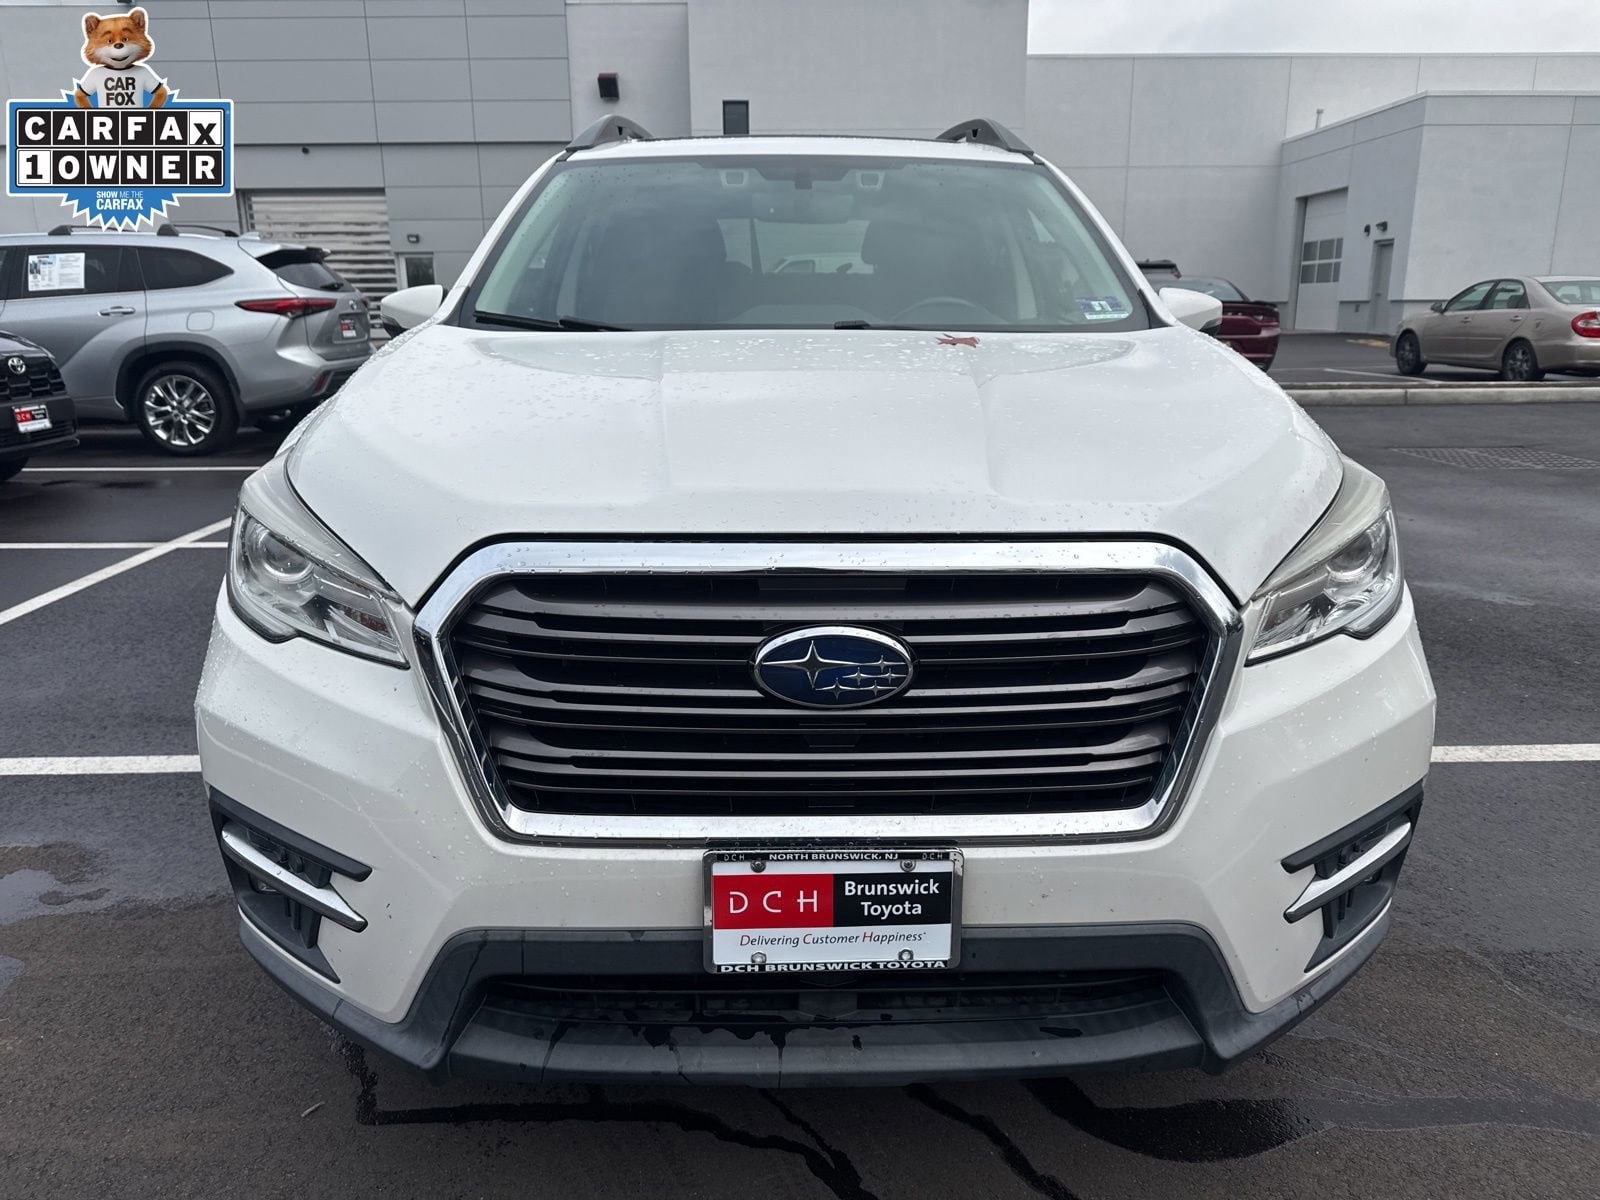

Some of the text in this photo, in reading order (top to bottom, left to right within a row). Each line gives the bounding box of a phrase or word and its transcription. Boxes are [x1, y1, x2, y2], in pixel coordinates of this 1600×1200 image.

[769, 852, 899, 861] NORTH BRUNSWICK, NJ
[844, 878, 940, 896] Brunswick
[861, 901, 922, 920] Toyota
[740, 934, 800, 948] Delivering
[803, 933, 860, 945] Customer
[721, 960, 945, 973] DCH BRUNSWICK TOYOTA
